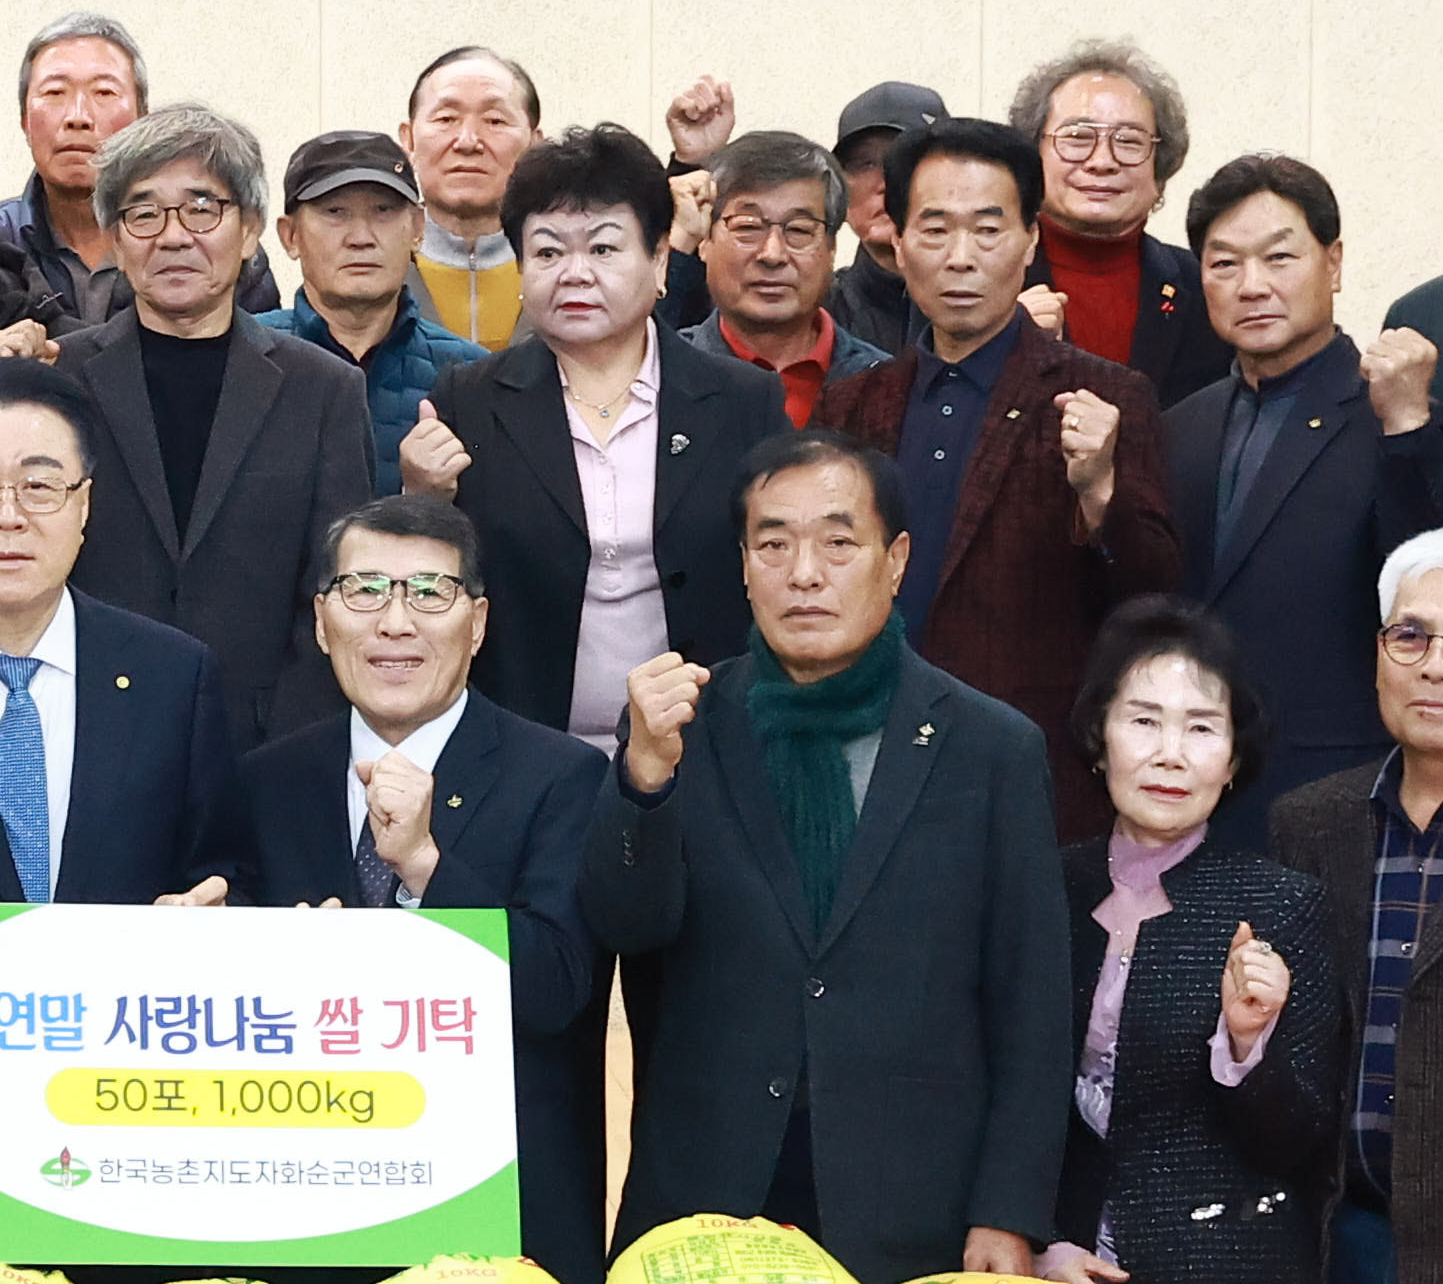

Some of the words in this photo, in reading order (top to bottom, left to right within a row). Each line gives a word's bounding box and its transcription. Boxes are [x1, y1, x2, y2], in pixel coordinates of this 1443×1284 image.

[104, 995, 297, 1055] 사랑나눔
[314, 996, 363, 1055] 쌀
[380, 996, 478, 1055] 기탁
[95, 1079, 198, 1116] 50포,
[211, 1078, 375, 1122] 1,000kg
[99, 1158, 433, 1186] 한국농촌지도자화순군연합회
